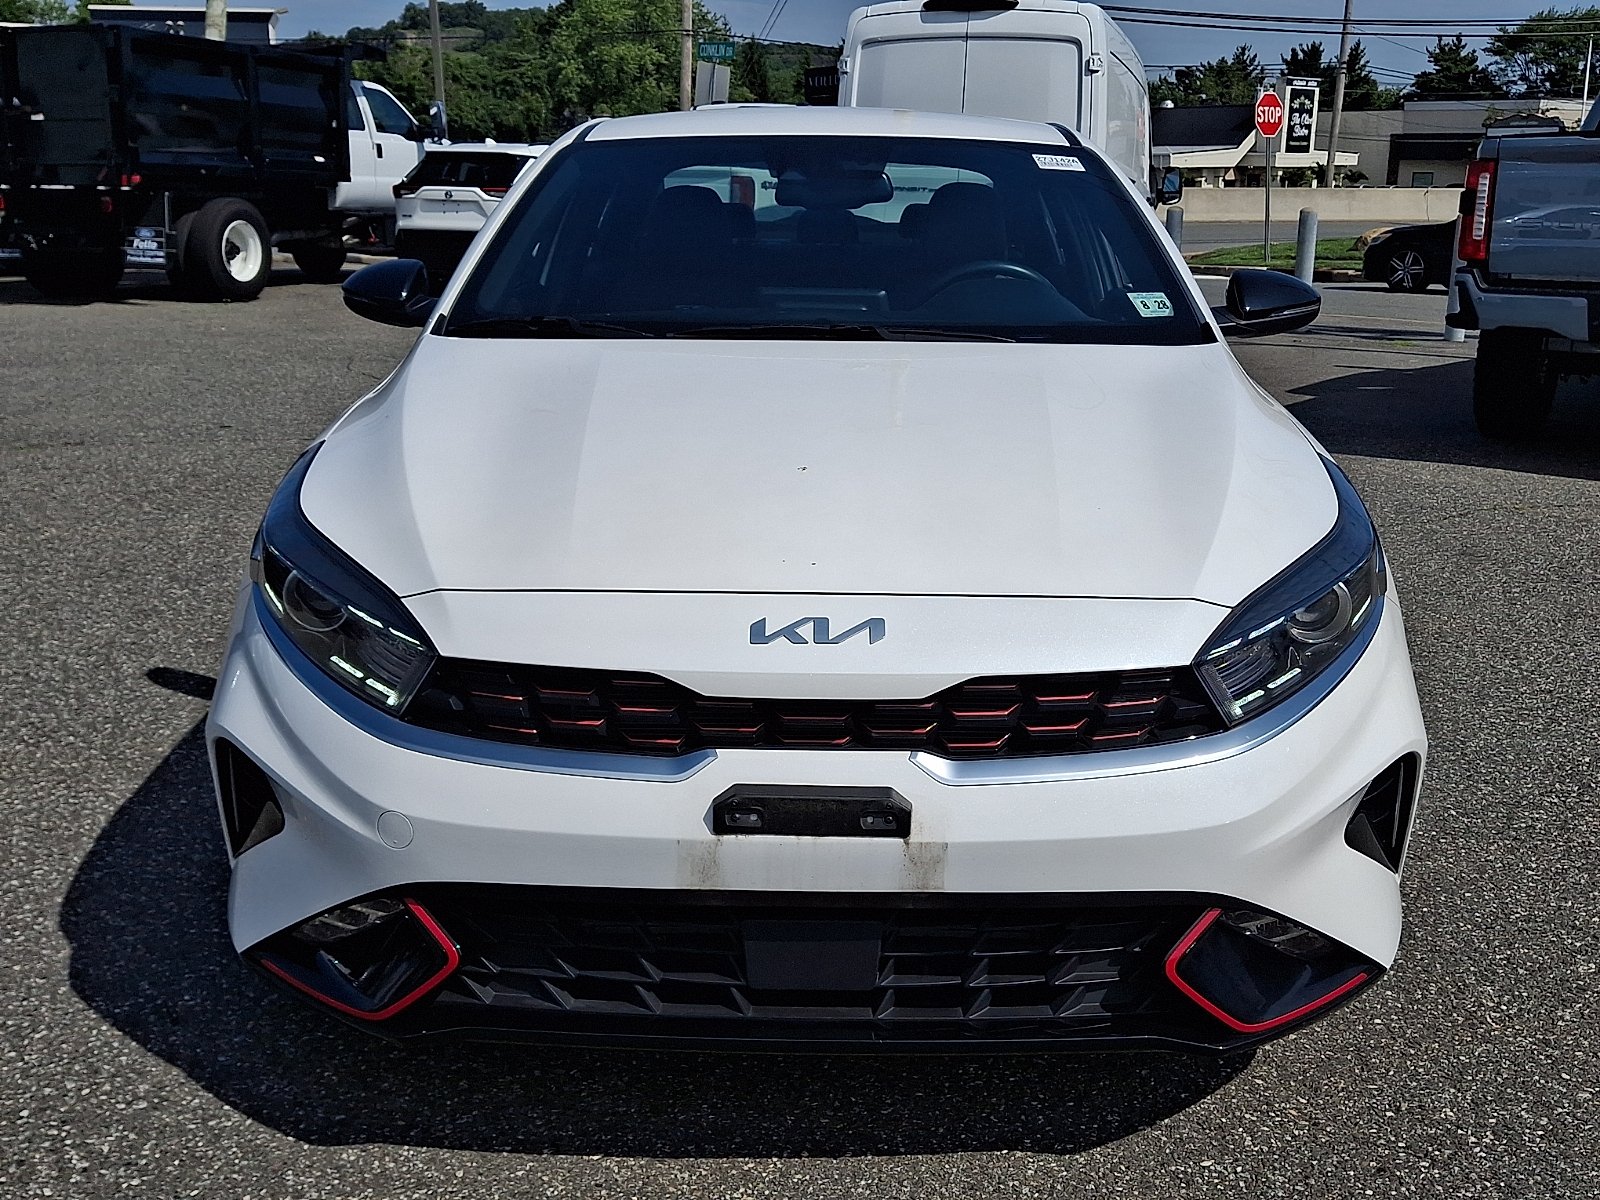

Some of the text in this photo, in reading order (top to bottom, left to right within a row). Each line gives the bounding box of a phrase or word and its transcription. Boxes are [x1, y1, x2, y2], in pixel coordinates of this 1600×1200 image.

[700, 44, 726, 57] CONKLIN
[1257, 106, 1281, 123] STOP
[1140, 300, 1170, 310] 8 28
[750, 617, 886, 645] KIA
